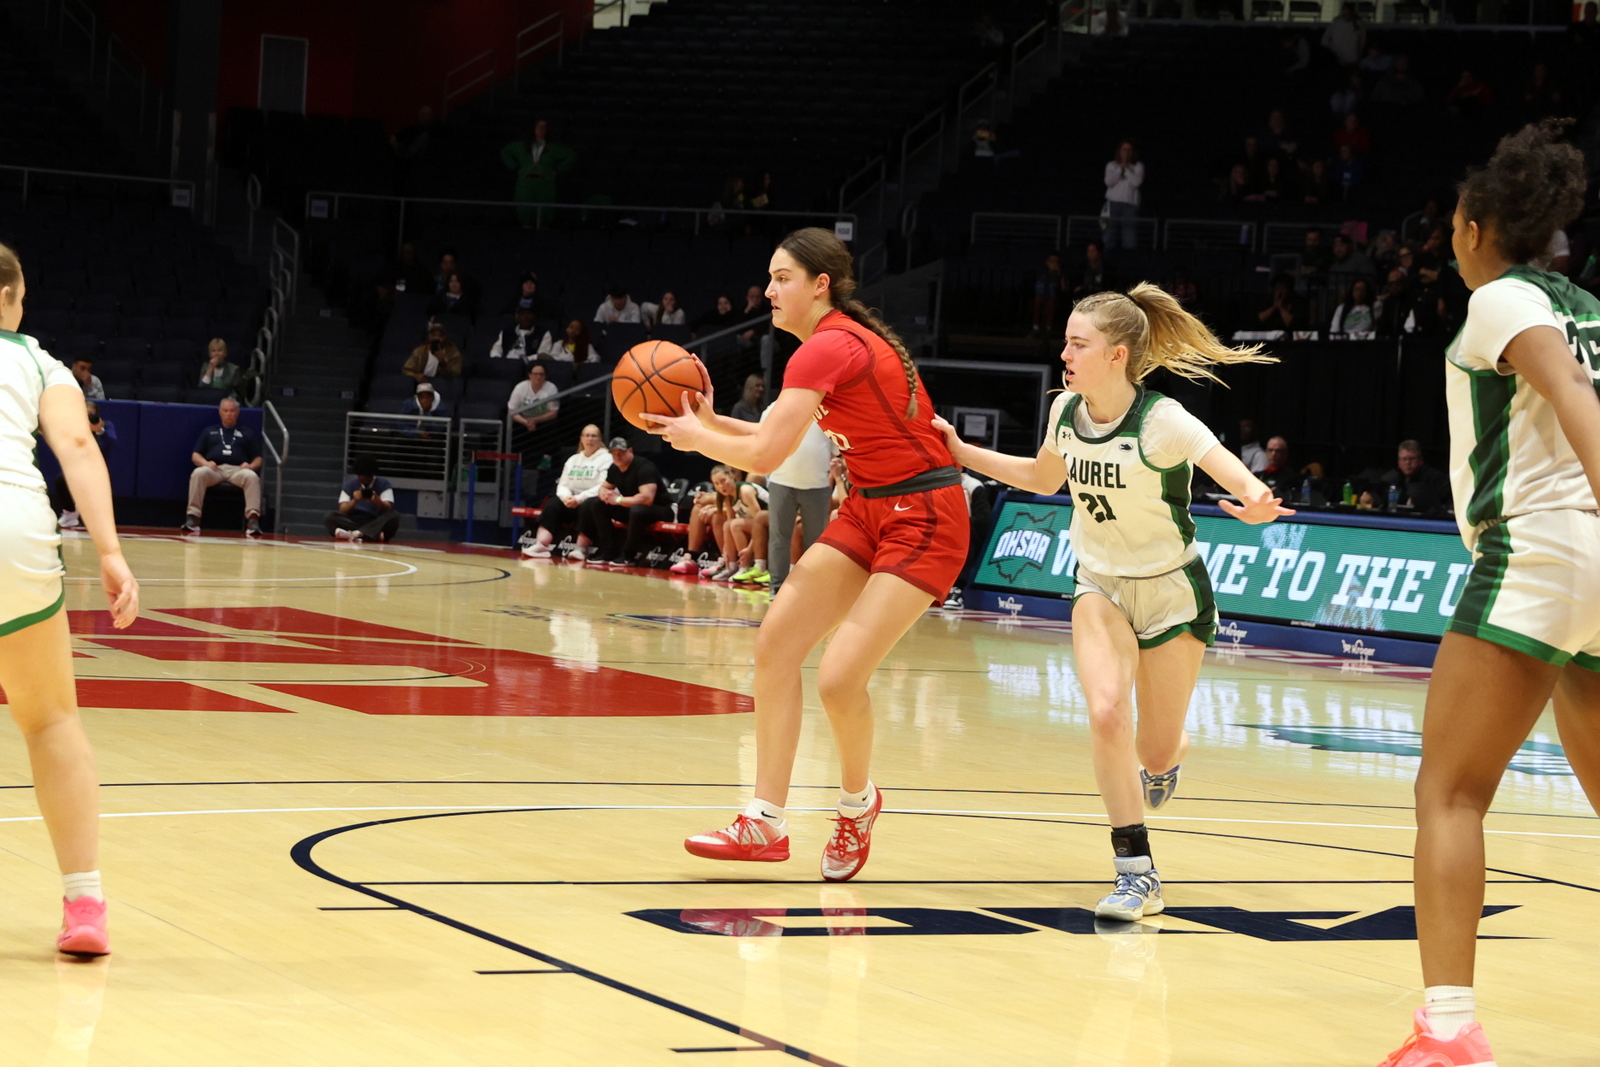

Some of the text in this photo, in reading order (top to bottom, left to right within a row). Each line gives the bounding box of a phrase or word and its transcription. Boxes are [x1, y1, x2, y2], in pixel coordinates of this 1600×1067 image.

[1078, 492, 1117, 523] 21
[993, 529, 1052, 564] OHSAA
[1261, 547, 1327, 602] TO
[1330, 553, 1437, 614] THE
